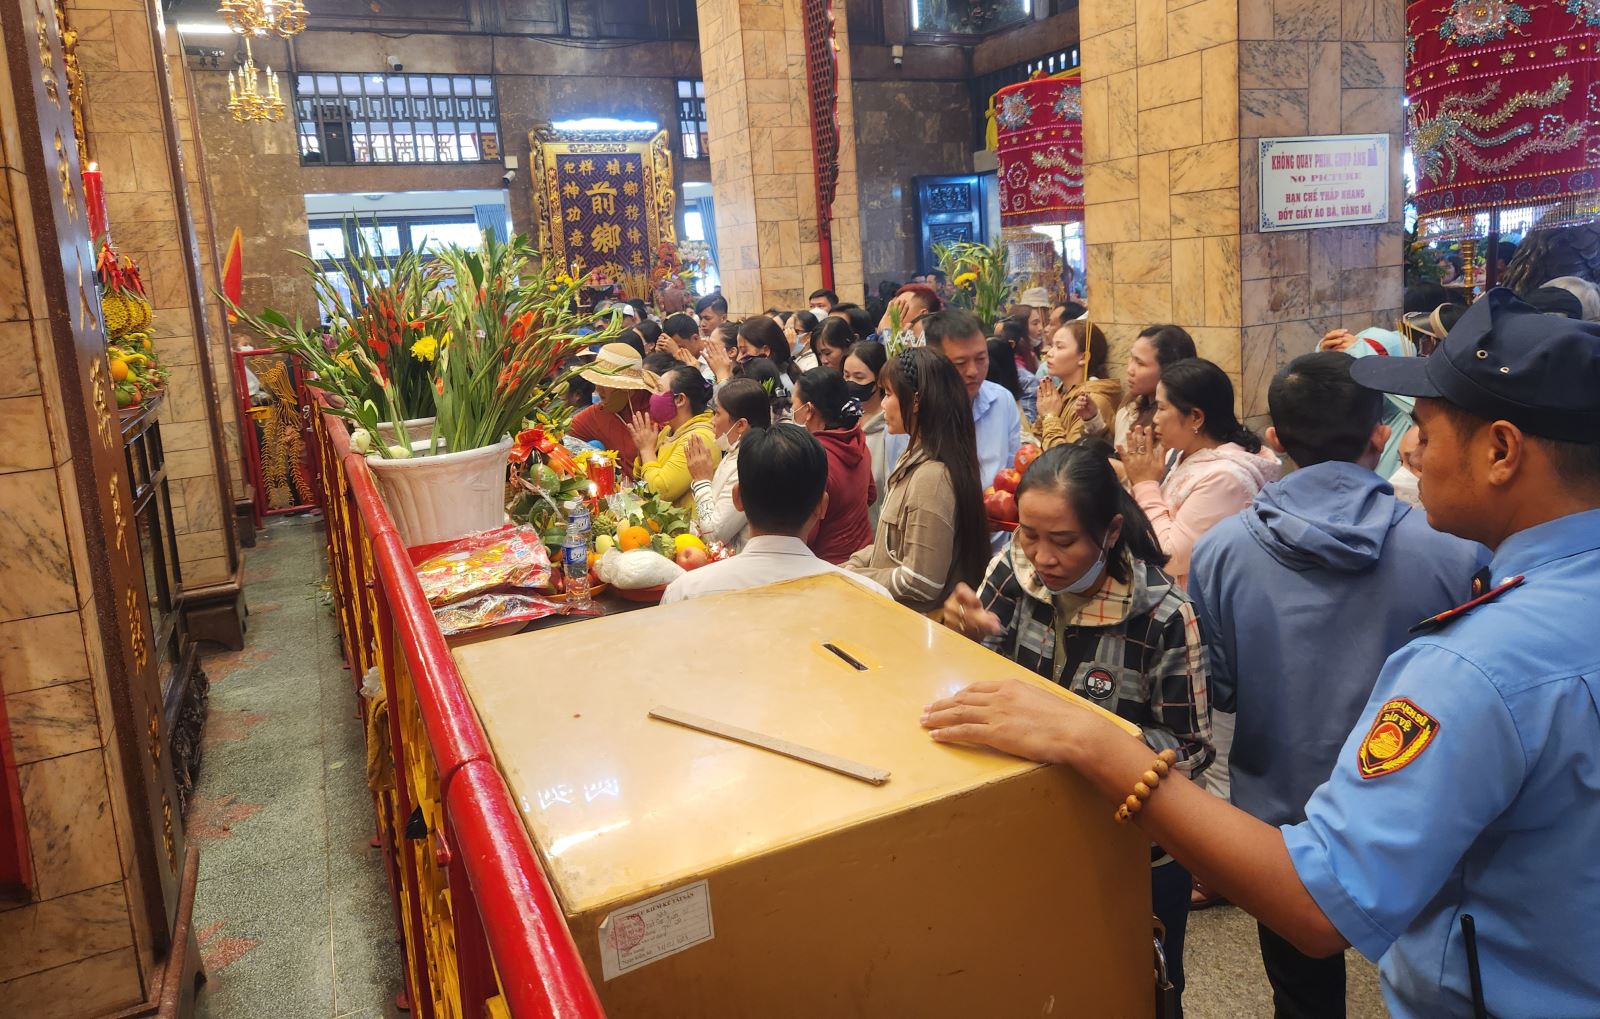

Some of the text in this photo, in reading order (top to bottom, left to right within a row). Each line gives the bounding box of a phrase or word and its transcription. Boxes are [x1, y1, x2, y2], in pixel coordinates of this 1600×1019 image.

[1272, 152, 1294, 170] KHÔNG
[1297, 153, 1312, 170] QUAY
[1290, 172, 1360, 183] NO PICTURE
[1285, 192, 1300, 205] HẠN
[1303, 187, 1318, 202] CHẾ
[1341, 189, 1365, 200] NHANG
[1278, 206, 1293, 221] ĐỐT
[1296, 205, 1312, 219] GIẤY
